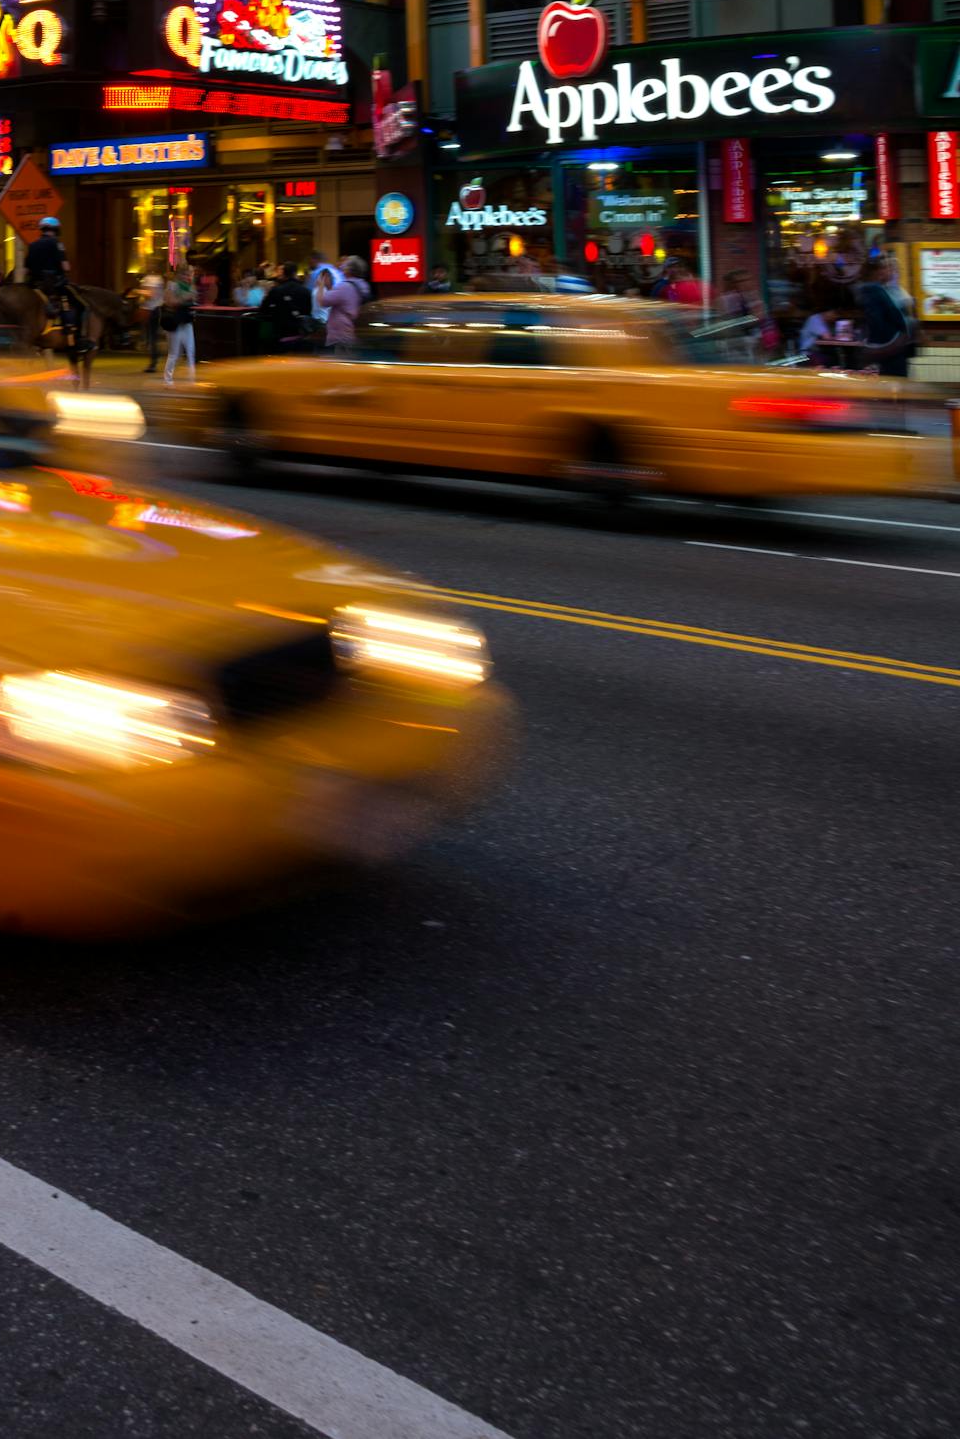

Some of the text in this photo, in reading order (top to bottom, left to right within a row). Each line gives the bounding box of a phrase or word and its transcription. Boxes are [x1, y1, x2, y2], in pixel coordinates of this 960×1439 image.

[199, 35, 349, 85] Famous Dave's
[506, 55, 836, 144] Applebee's
[51, 133, 205, 169] DAVE & BUSTER'S
[445, 201, 548, 231] Applebee's
[373, 251, 419, 266] Applebee's
